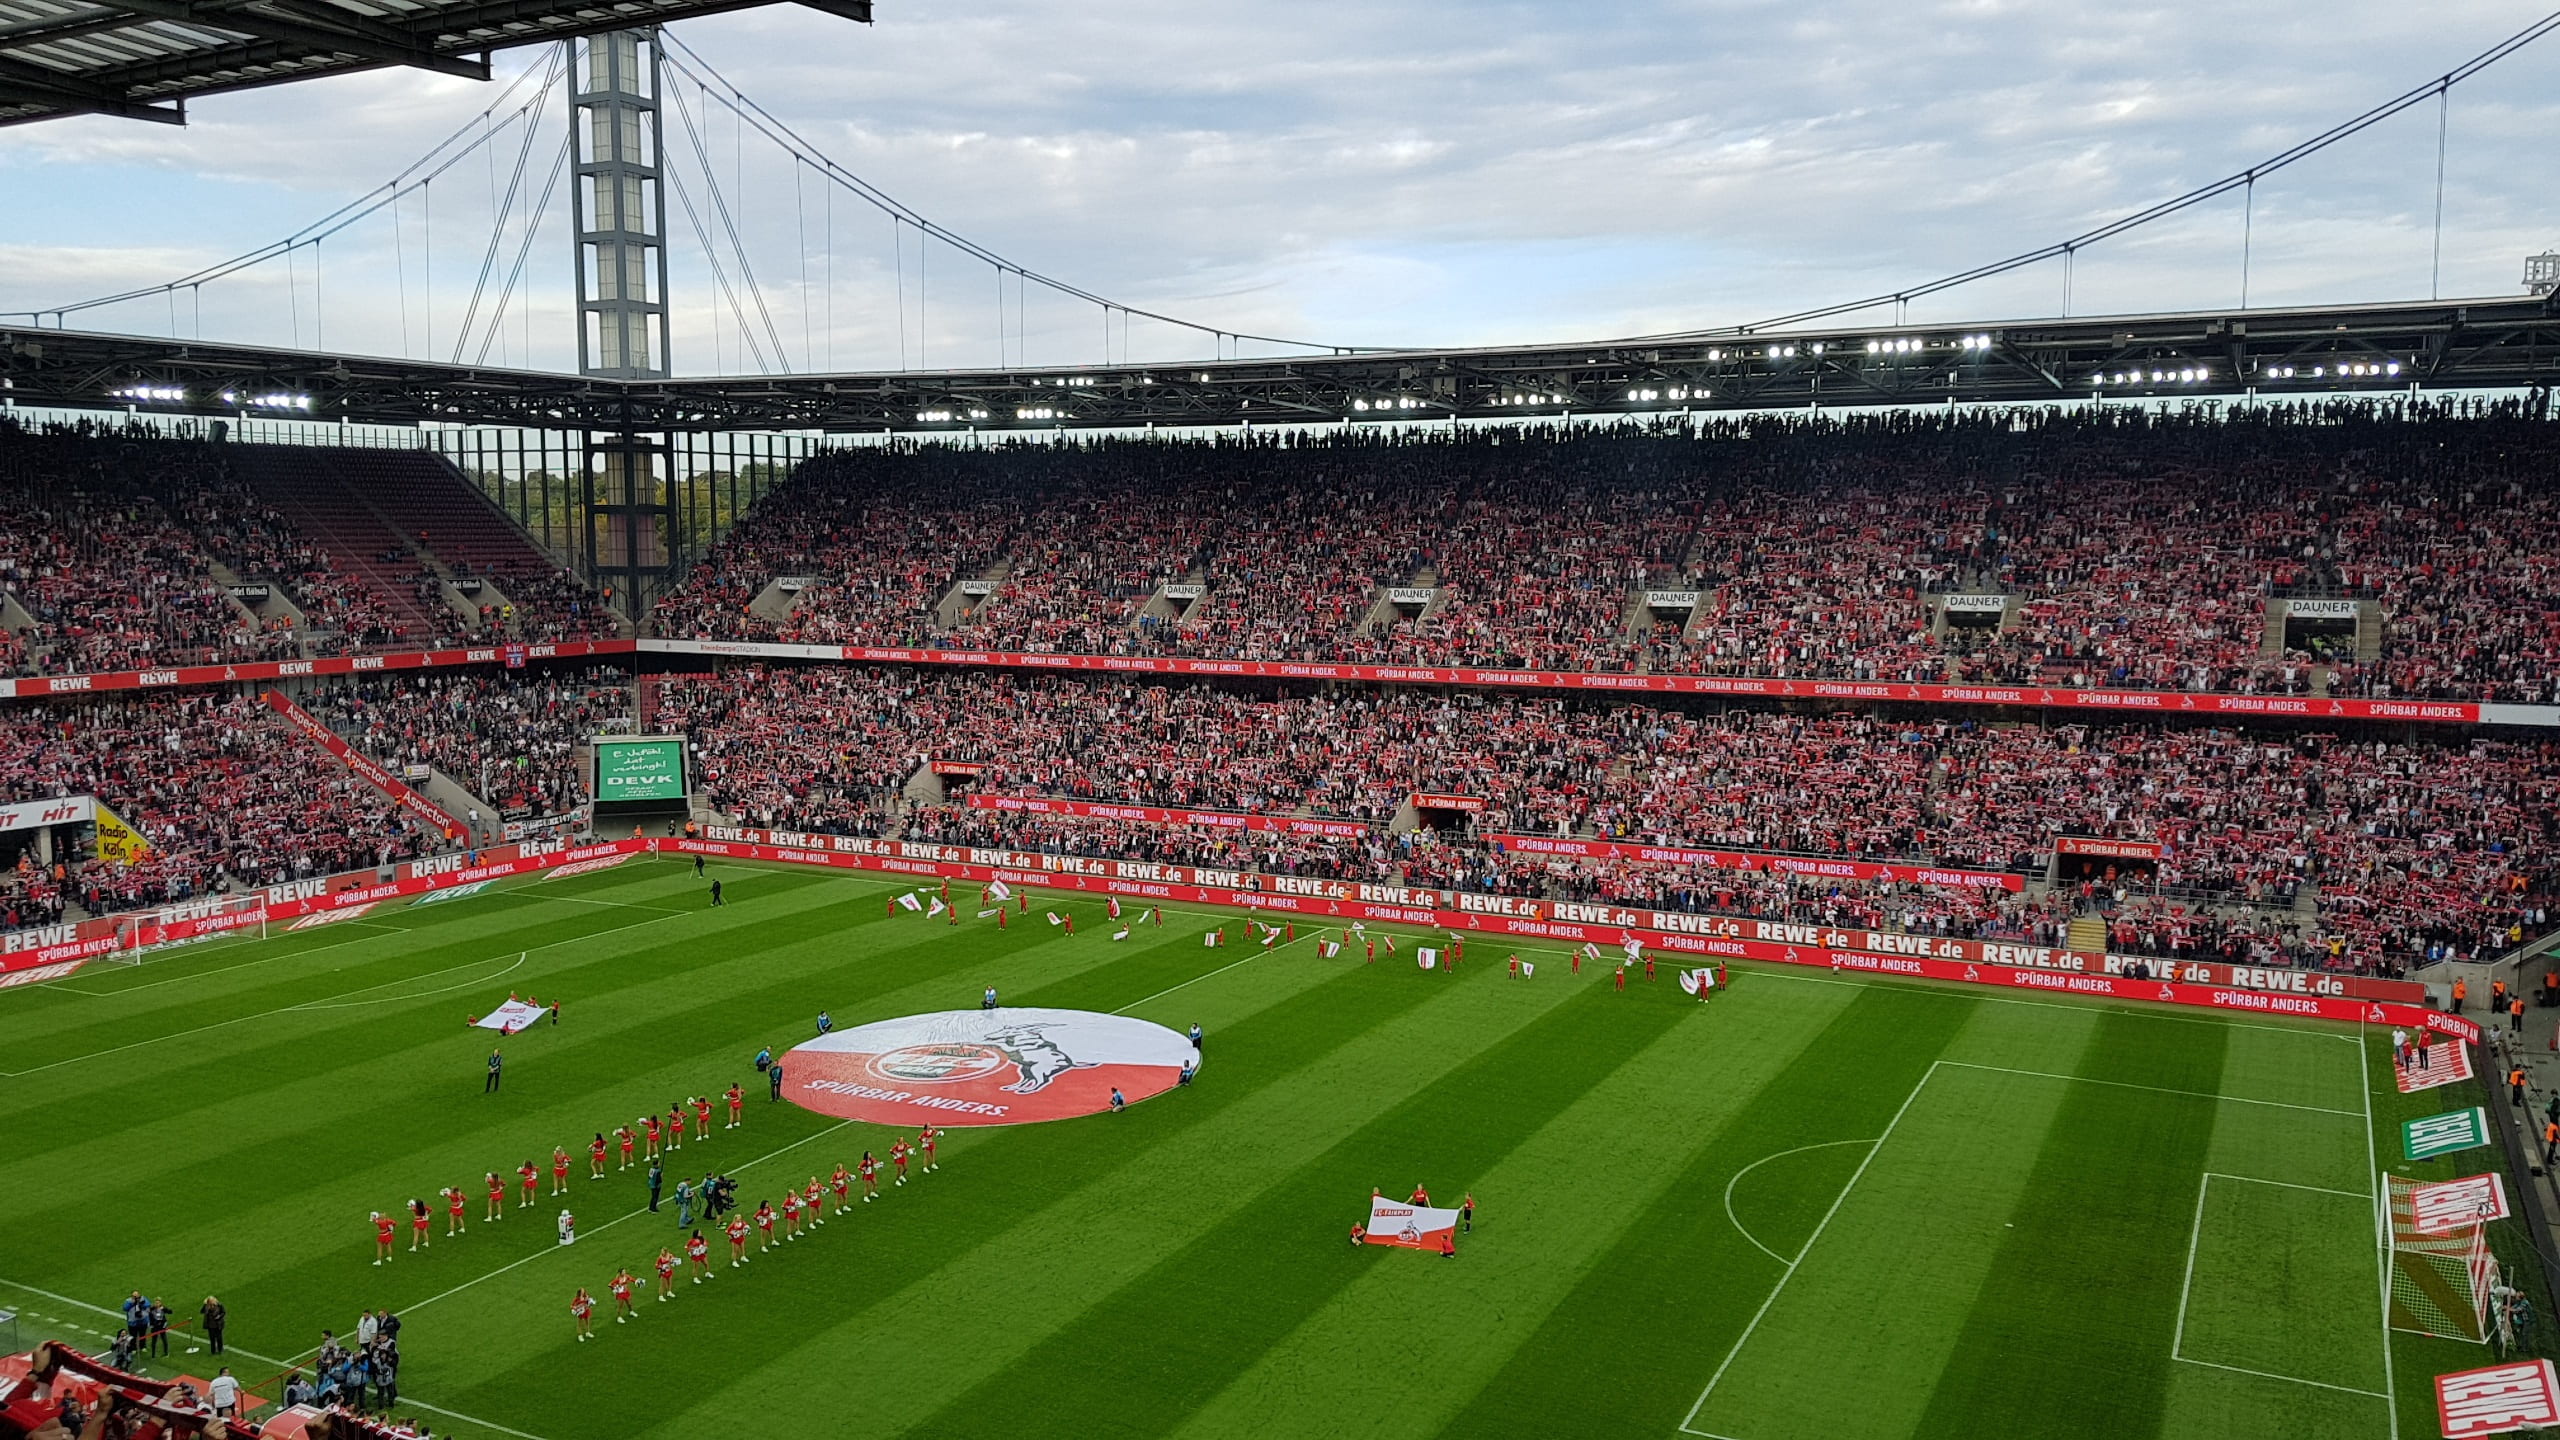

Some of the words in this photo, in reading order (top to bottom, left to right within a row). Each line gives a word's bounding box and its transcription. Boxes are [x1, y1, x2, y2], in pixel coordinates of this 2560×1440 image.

[965, 582, 997, 591] DAUNER
[1167, 586, 1202, 594] DAUNER
[1394, 589, 1432, 598] DAUNER
[1651, 593, 1695, 602] DAUNER
[1950, 596, 2000, 606] DAUNER
[2292, 602, 2350, 612] DAUNER
[467, 650, 496, 661] REWE
[530, 646, 556, 656] REWE
[279, 662, 314, 674] REWE
[352, 656, 384, 670] REWE
[1190, 662, 1217, 671] SPÜRBAR
[1280, 665, 1309, 674] SPÜRBAR
[140, 672, 178, 685] REWE
[1376, 668, 1405, 678] SPÜRBAR
[1476, 672, 1508, 682] SPÜRBAR
[50, 677, 91, 691] REWE
[1582, 676, 1616, 686] SPÜRBAR
[1618, 678, 1650, 688] ANDERS.
[1695, 680, 1731, 690] SPÜRBAR
[1733, 682, 1766, 692] ANDERS.
[1815, 684, 1853, 695] SPÜRBAR
[1856, 686, 1890, 696] ANDERS.
[1942, 688, 1982, 699] SPÜRBAR
[1985, 690, 2022, 700] ANDERS.
[2078, 693, 2120, 704] SPÜRBAR
[2122, 694, 2162, 706] ANDERS.
[2220, 698, 2264, 710] SPÜRBAR
[2267, 700, 2309, 712] ANDERS.
[2370, 703, 2418, 715] SPÜRBAR
[2420, 706, 2464, 718] ANDERS.
[606, 774, 673, 786] DEVK
[404, 790, 451, 829] Aspecton
[1089, 806, 1118, 817] SPÜRBAR
[100, 824, 128, 839] Radio
[708, 825, 760, 844] REWE.de
[520, 836, 565, 858] REWE
[678, 840, 704, 850] SPÜRBAR
[706, 842, 729, 853] ANDERS.
[770, 831, 824, 850] REWE.de
[834, 837, 890, 855] REWE.de
[1517, 840, 1552, 852] SPÜRBAR
[1556, 842, 1588, 855] ANDERS.
[566, 848, 593, 860] SPÜRBAR
[594, 844, 618, 856] ANDERS.
[778, 850, 803, 861] SPÜRBAR
[806, 852, 830, 864] ANDERS.
[902, 844, 960, 862] REWE.de
[1641, 849, 1680, 862] SPÜRBAR
[2080, 843, 2118, 855] SPÜRBAR
[2120, 846, 2154, 858] ANDERS.
[412, 855, 462, 878] REWE
[882, 860, 910, 872] SPÜRBAR
[912, 862, 938, 874] ANDERS.
[970, 850, 1030, 868] REWE.de
[457, 868, 488, 882] SPÜRBAR
[490, 862, 515, 876] ANDERS.
[1117, 862, 1182, 882] REWE.de
[1774, 859, 1816, 872] SPÜRBAR
[1818, 863, 1856, 876] ANDERS.
[992, 870, 1021, 882] SPÜRBAR
[1023, 873, 1050, 885] ANDERS.
[1194, 870, 1255, 889] REWE.d
[1917, 870, 1962, 884] SPÜRBAR
[269, 880, 326, 905] REWE
[334, 891, 368, 905] SPÜRBAR
[371, 884, 400, 898] ANDERS.
[1108, 880, 1140, 893] SPÜRBAR
[1142, 884, 1170, 896] ANDERS.
[1276, 877, 1345, 898] REWE.de
[1232, 893, 1266, 906] SPÜRBAR
[1268, 896, 1298, 910] ANDERS.
[1360, 885, 1434, 907] REWE.de
[1460, 894, 1538, 916] REWE.de
[1364, 906, 1400, 920] SPÜRBAR
[1403, 909, 1436, 924] ANDERS.
[1554, 902, 1636, 927] REWE.de
[195, 916, 233, 932] SPÜRBAR
[1508, 920, 1546, 934] SPÜRBAR
[1549, 924, 1584, 938] ANDERS.
[5, 924, 77, 954] REWE
[1757, 922, 1848, 948] REWEde
[37, 944, 82, 962] SPÜRBAR
[1662, 936, 1704, 950] SPÜRBAR
[1708, 940, 1746, 955] ANDERS.
[1867, 932, 1963, 959] REWE.de
[1831, 952, 1878, 968] SPÜRBAR
[1880, 958, 1923, 974] ANDERS.
[1983, 944, 2084, 970] REWE.de
[2015, 971, 2065, 988] SPÜRBAR
[2068, 978, 2114, 994] ANDERS.
[2232, 967, 2344, 996] REWE.de
[2214, 991, 2268, 1008] SPÜRBAR
[2270, 996, 2320, 1014] ANDERS.
[2428, 1013, 2469, 1037] SPÜRBAR
[802, 1080, 910, 1104] SPÜRBAR
[913, 1094, 1010, 1117] ANDERS.
[2409, 1112, 2474, 1154] DEVK
[2441, 1365, 2552, 1432] REWE
